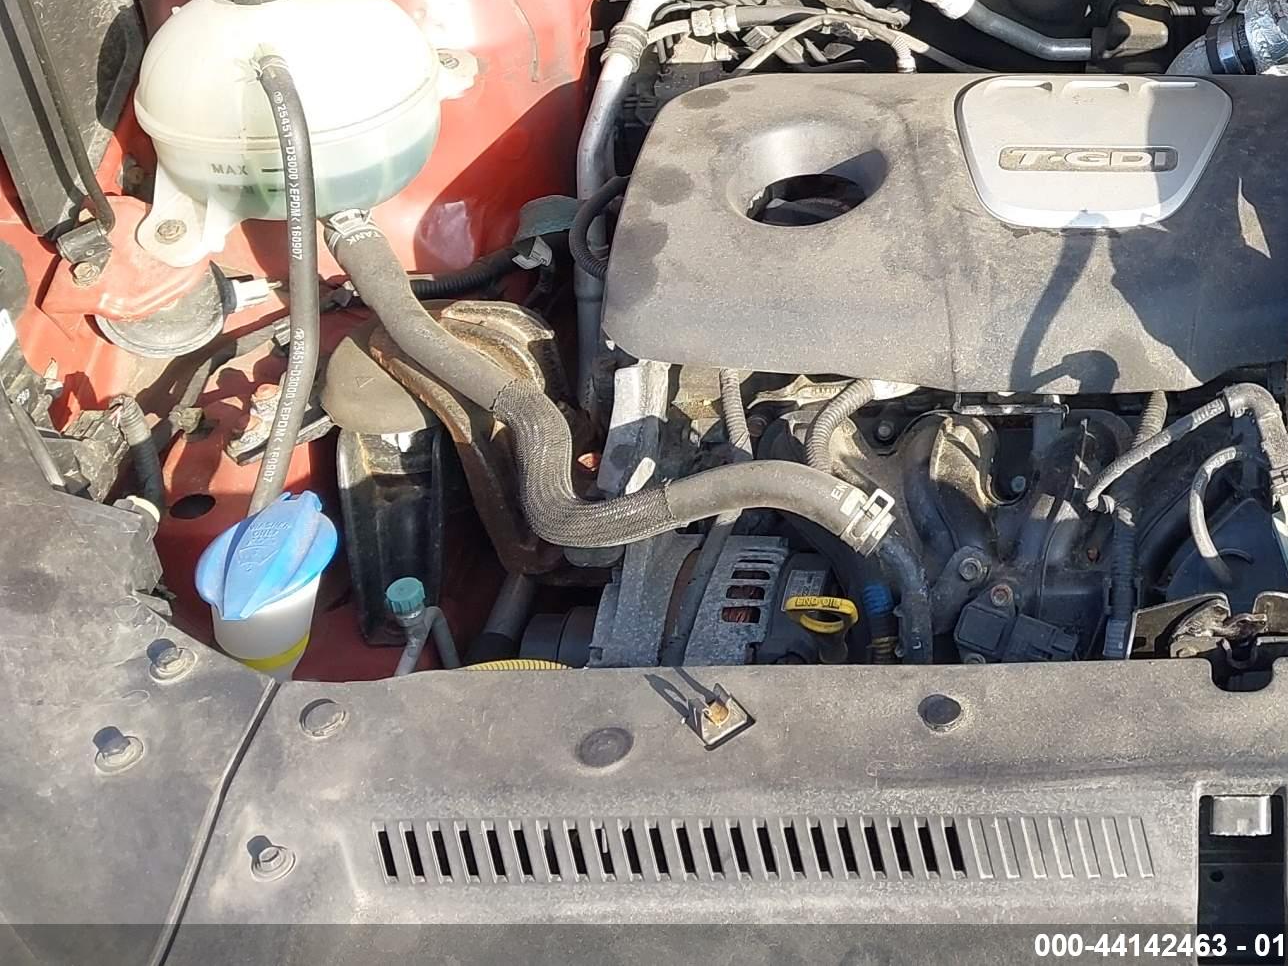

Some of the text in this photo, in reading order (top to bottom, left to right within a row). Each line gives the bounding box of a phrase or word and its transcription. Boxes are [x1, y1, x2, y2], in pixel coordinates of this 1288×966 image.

[211, 163, 248, 176] MAX
[277, 104, 299, 180] 25451-D3000
[291, 225, 303, 260] 160907
[345, 230, 379, 246] TANK
[285, 340, 305, 399] 25451-D3000
[262, 446, 281, 483] 160907
[822, 598, 840, 609] OIL
